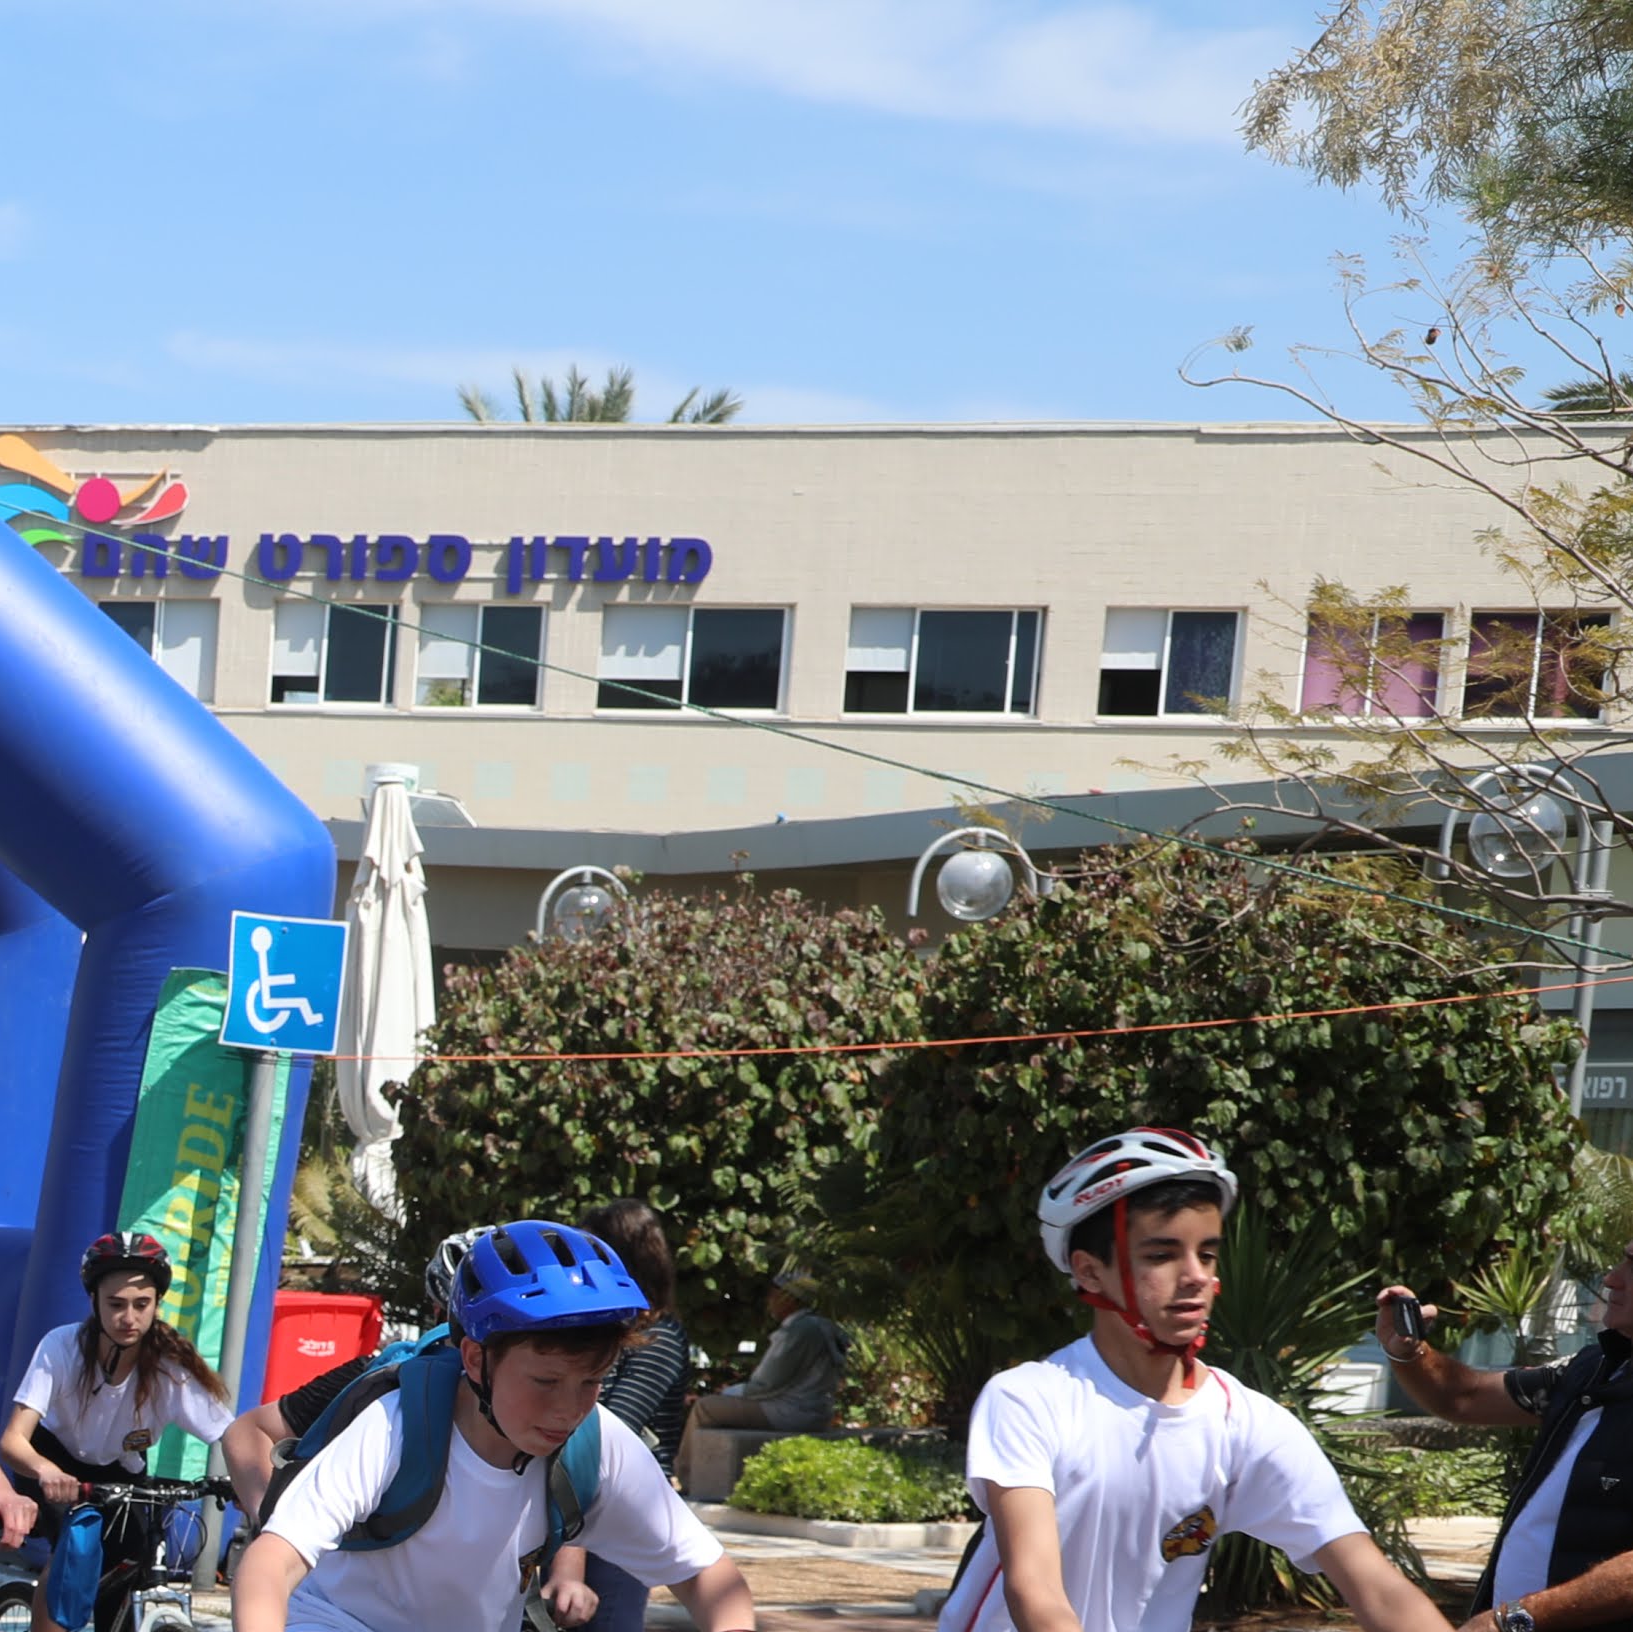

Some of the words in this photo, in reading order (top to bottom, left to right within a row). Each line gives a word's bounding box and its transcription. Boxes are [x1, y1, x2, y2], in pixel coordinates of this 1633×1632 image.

[81, 531, 230, 581] שהם
[257, 533, 473, 584] ספורט
[505, 536, 714, 596] מועדון
